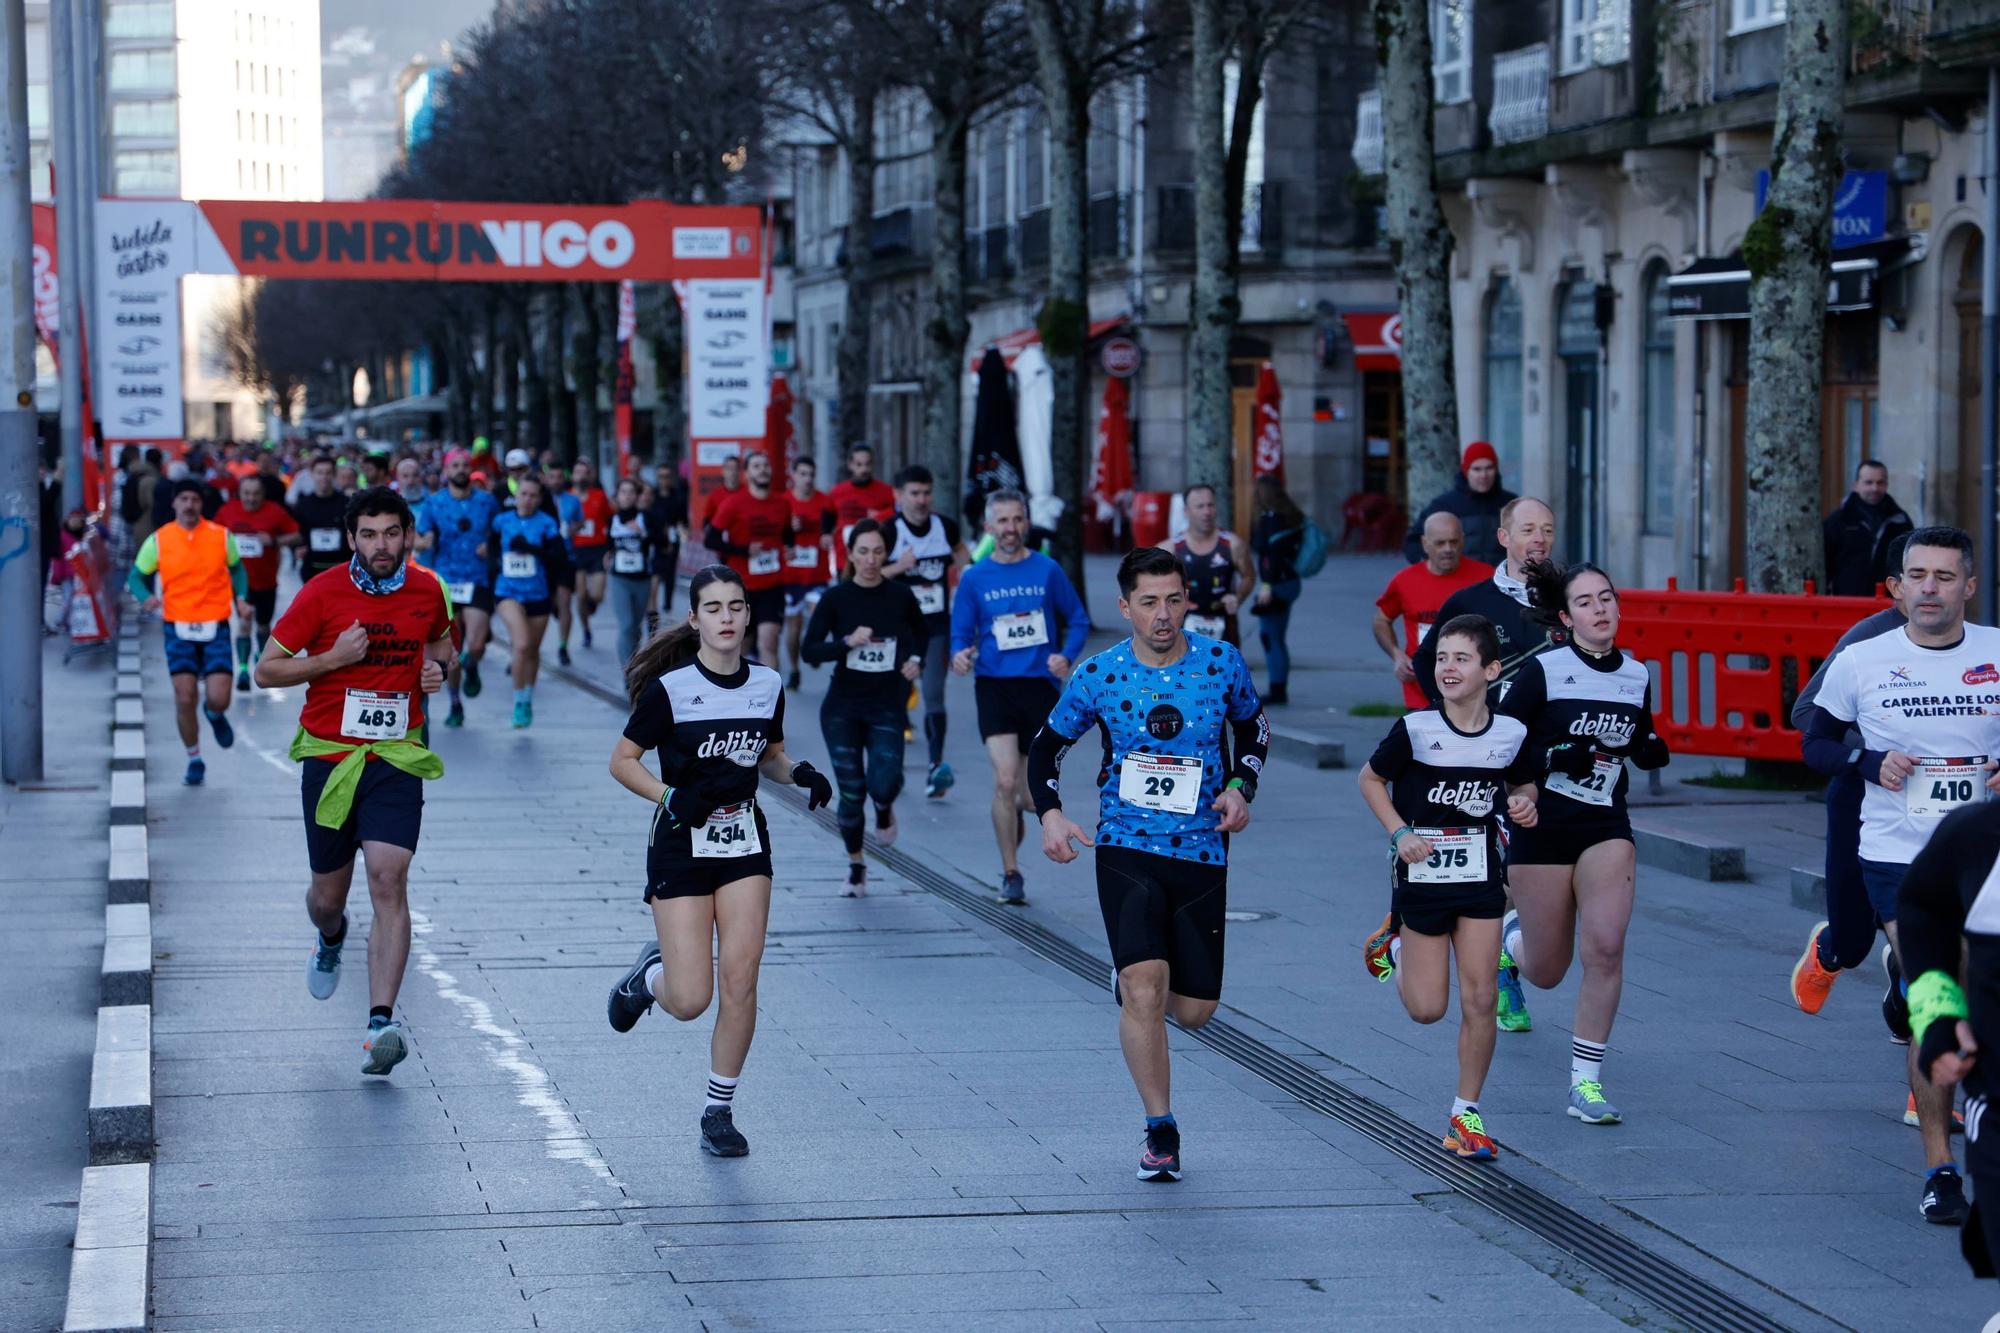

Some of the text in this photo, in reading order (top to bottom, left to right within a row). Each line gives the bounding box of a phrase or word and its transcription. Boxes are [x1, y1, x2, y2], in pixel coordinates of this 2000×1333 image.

[1008, 624, 1036, 638] 456
[859, 650, 885, 663] 426
[1882, 696, 1951, 708] CARRERA
[1955, 695, 1973, 705] DE
[358, 709, 396, 727] 483
[1903, 706, 1983, 718] VALIENTES
[1145, 776, 1175, 796] 29
[1930, 780, 1973, 801] 410
[706, 824, 746, 845] 434
[1427, 849, 1468, 868] 375
